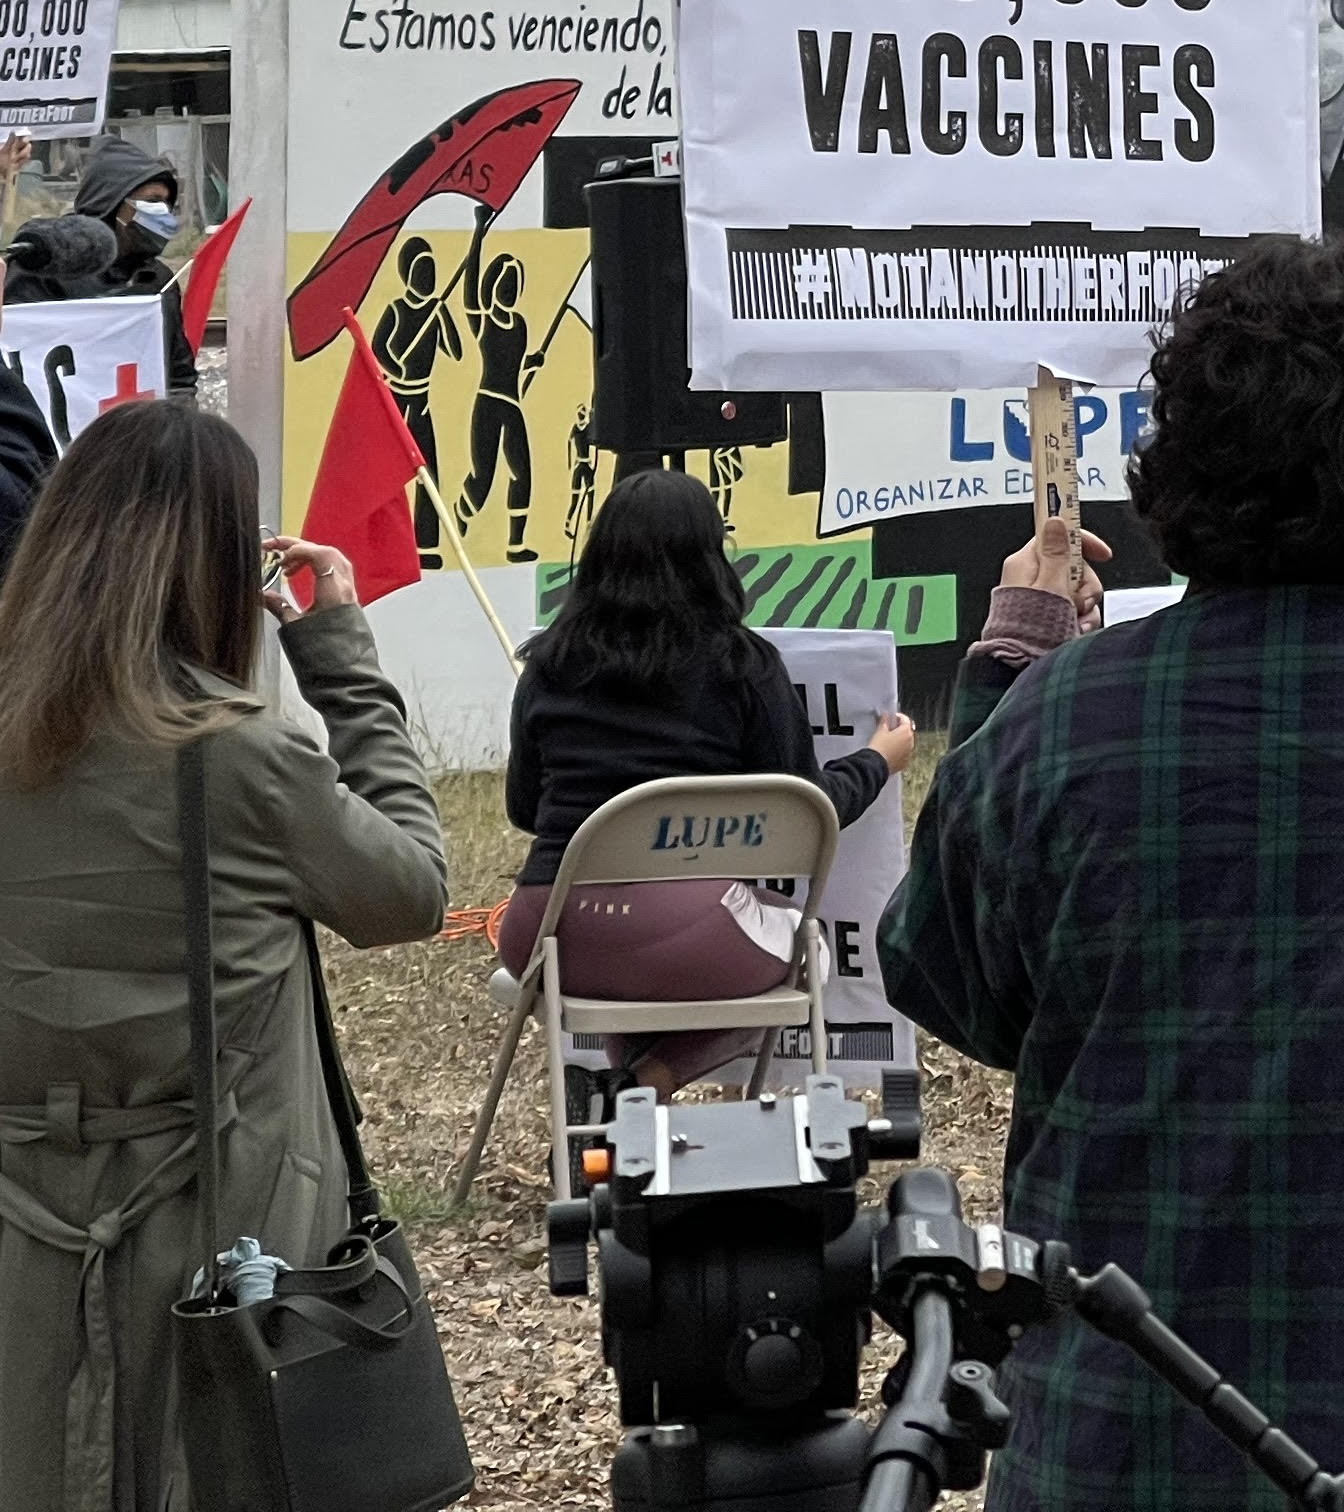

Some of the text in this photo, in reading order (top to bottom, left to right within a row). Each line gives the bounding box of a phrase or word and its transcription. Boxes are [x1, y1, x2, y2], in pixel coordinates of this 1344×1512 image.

[602, 61, 673, 119] de la
[797, 29, 1216, 163] VACCINES
[835, 476, 989, 520] ORGANIZAR
[650, 812, 768, 851] LUPE
[578, 899, 632, 916] PINK
